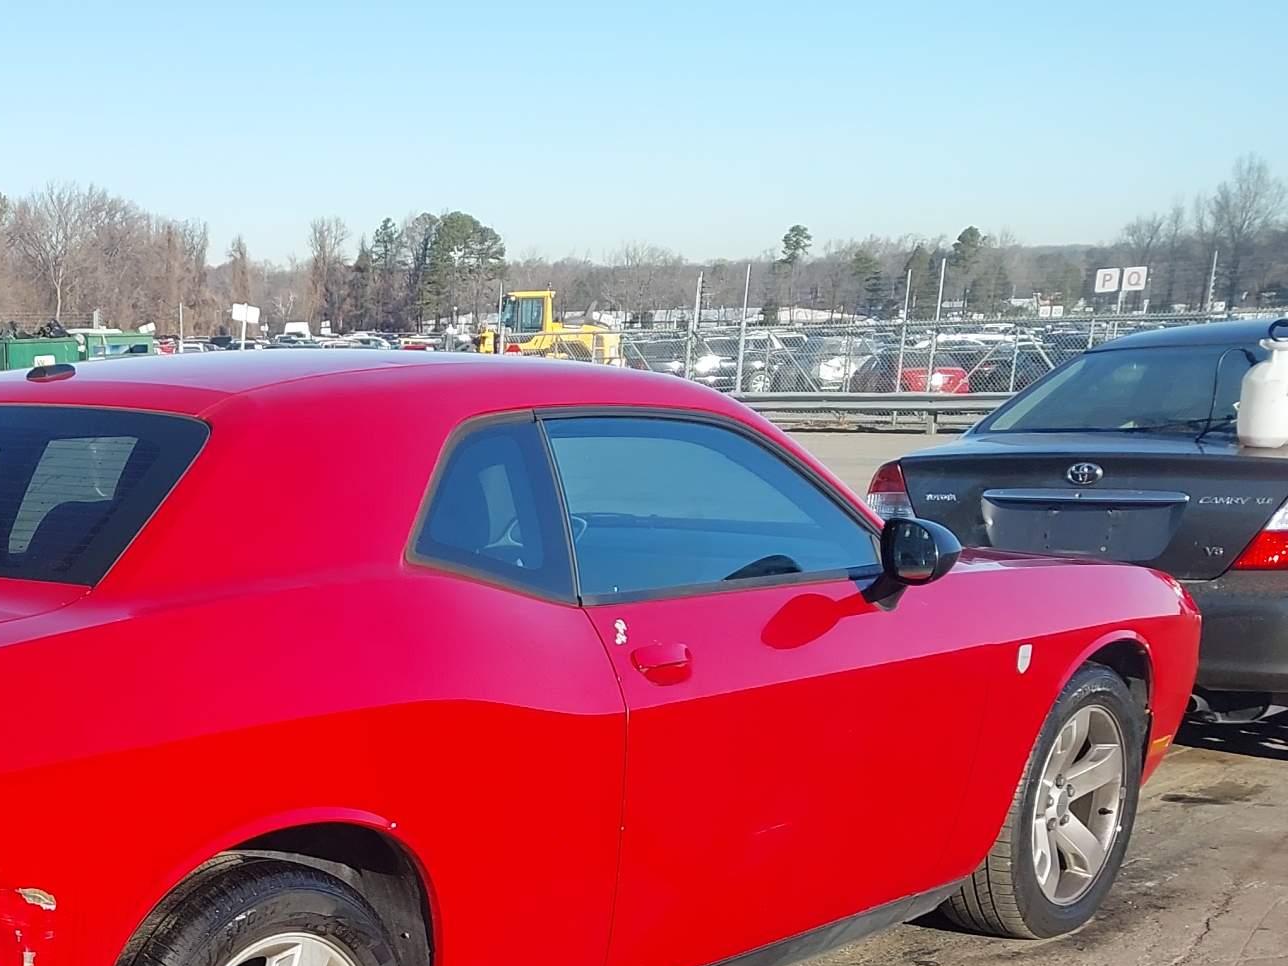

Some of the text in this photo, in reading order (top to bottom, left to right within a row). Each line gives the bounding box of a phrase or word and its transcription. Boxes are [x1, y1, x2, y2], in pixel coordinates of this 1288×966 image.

[1102, 271, 1142, 289] P Q
[1198, 496, 1251, 505] CAMRY
